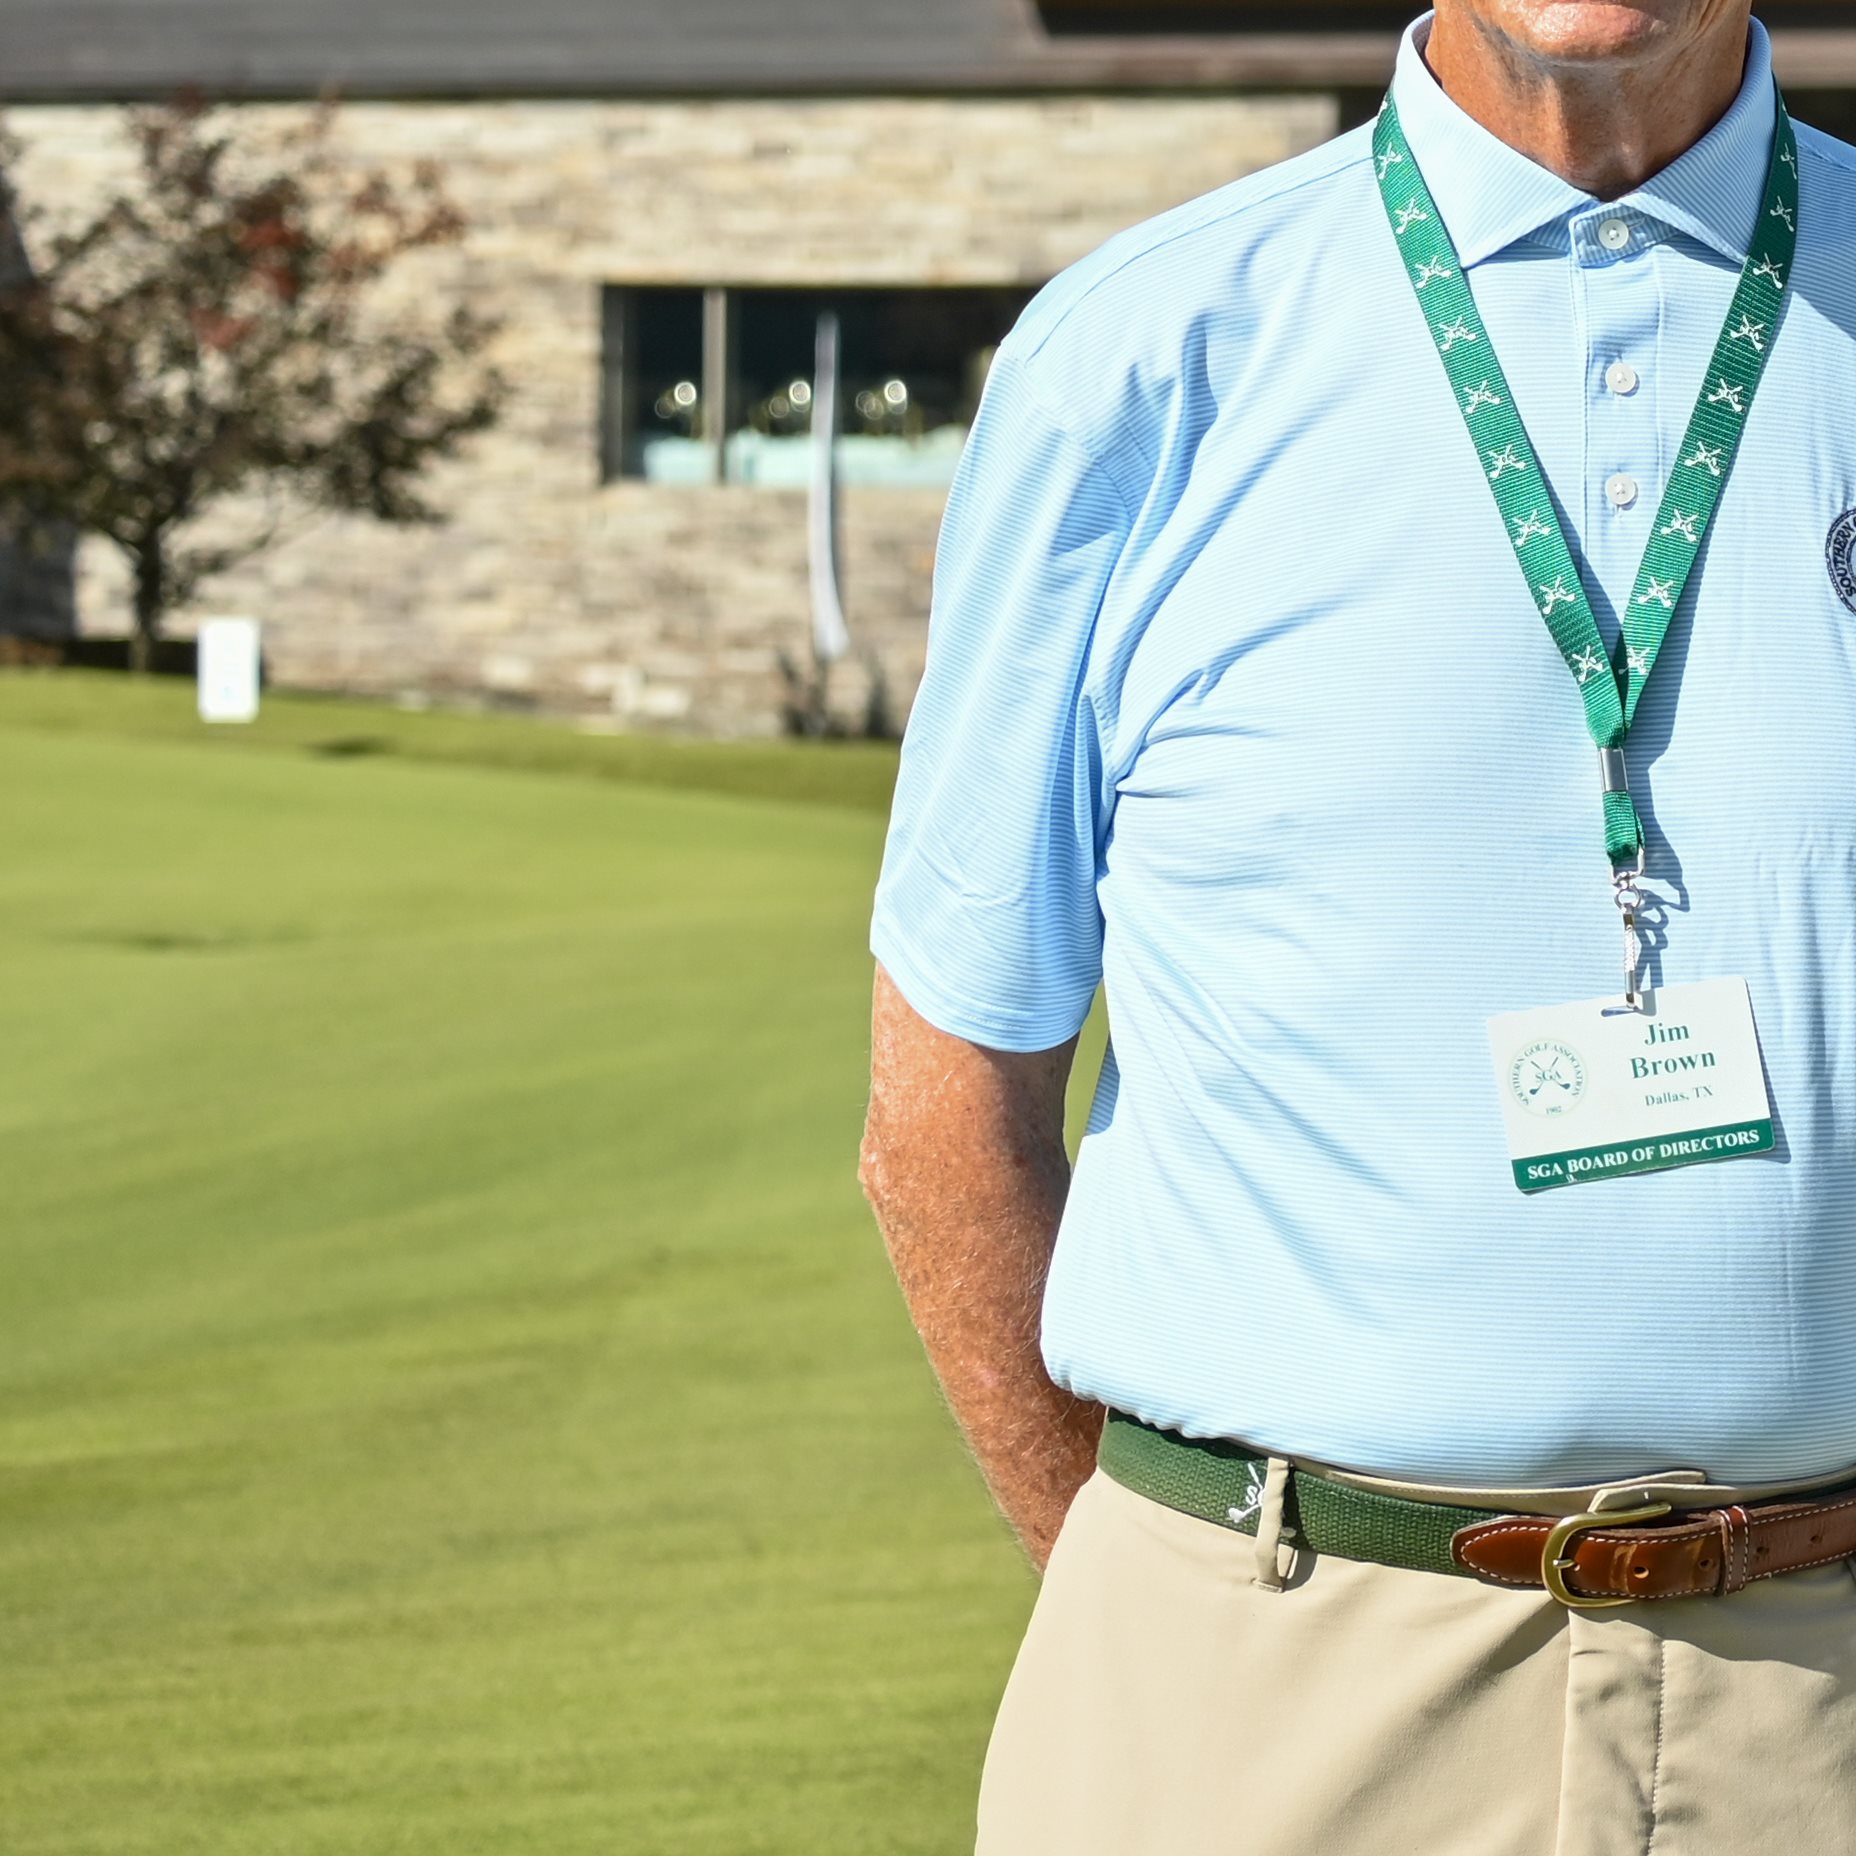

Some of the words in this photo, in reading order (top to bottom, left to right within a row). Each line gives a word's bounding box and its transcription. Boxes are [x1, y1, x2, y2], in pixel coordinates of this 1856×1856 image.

[1643, 1023, 1691, 1047] Jim
[1629, 1051, 1717, 1080] Brown
[1644, 1090, 1691, 1107] Dallas,
[1692, 1085, 1714, 1099] TX
[1527, 1160, 1564, 1180] SGA
[1566, 1150, 1629, 1174] BOARD
[1632, 1146, 1656, 1163] OF
[1659, 1128, 1761, 1159] DIRECTORS
